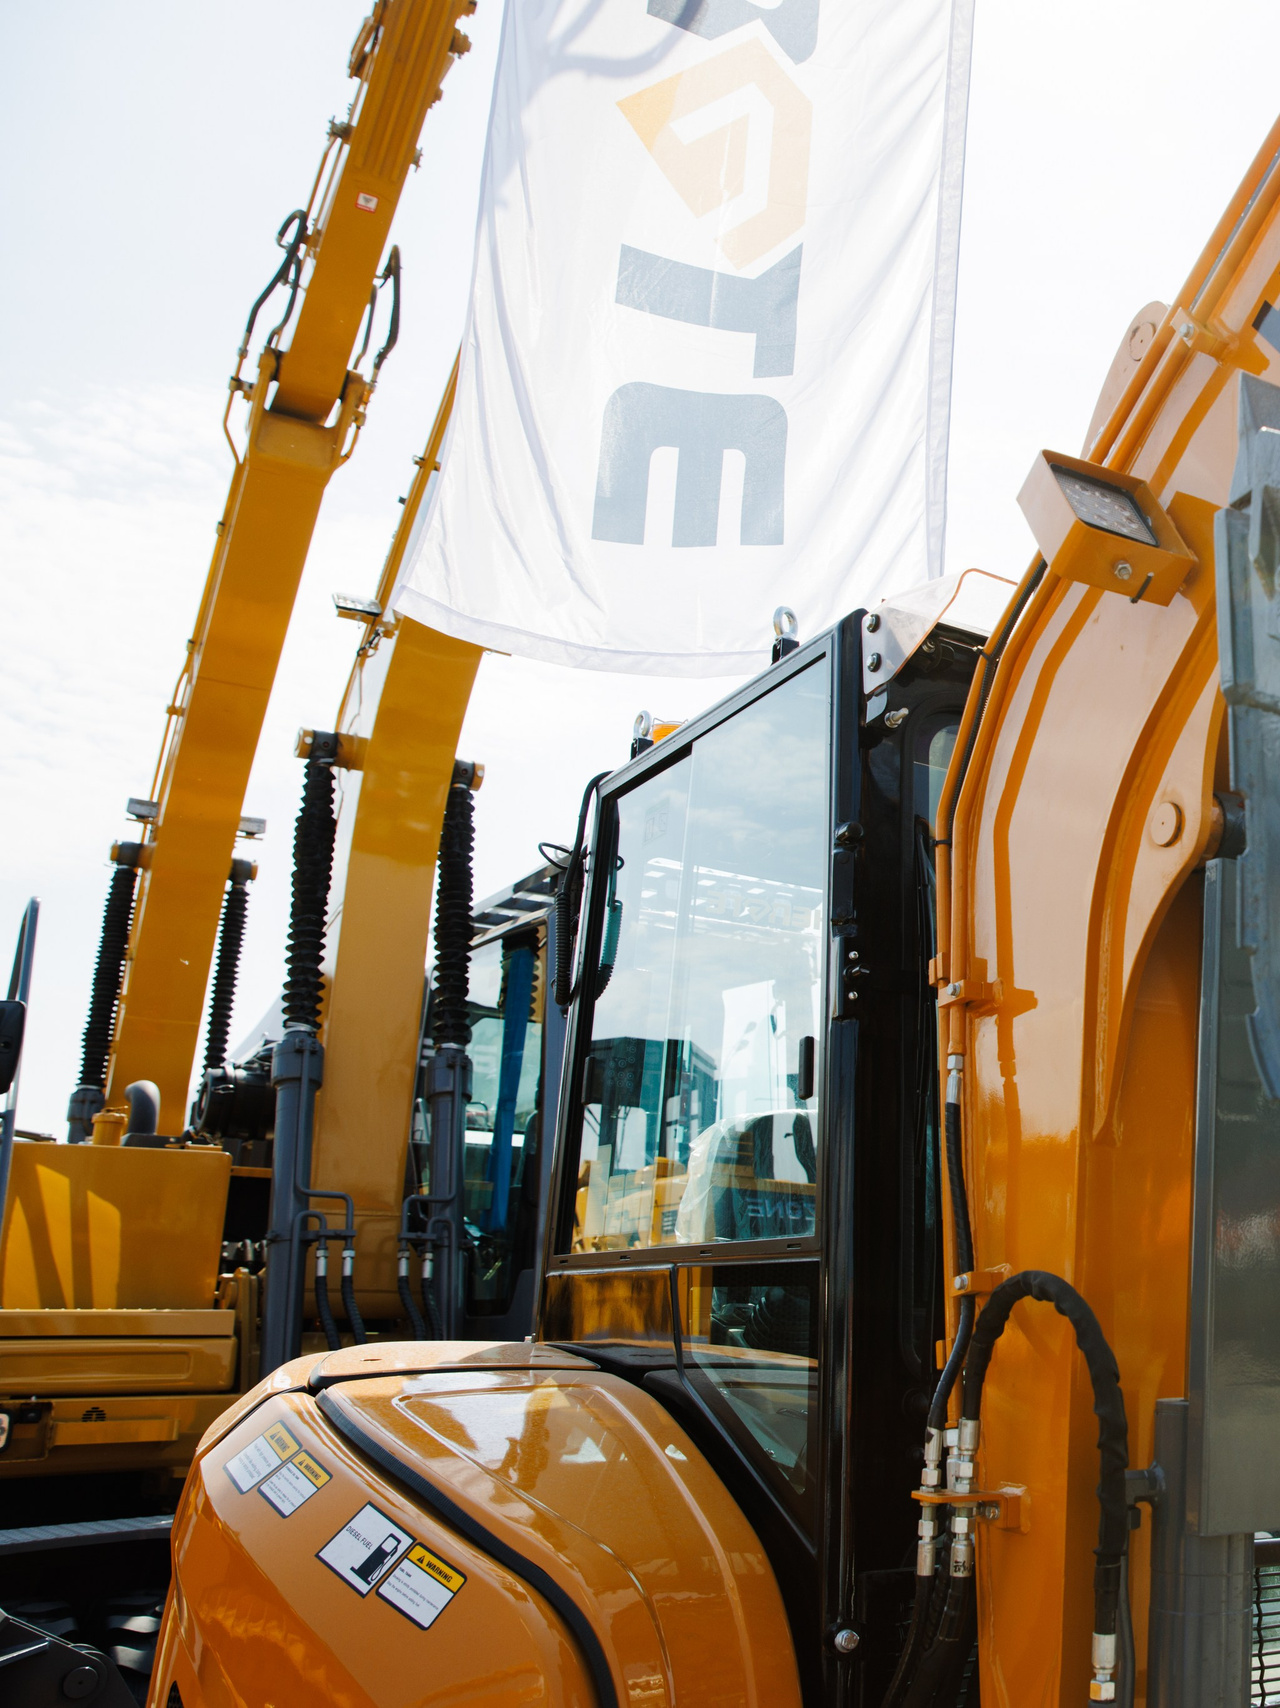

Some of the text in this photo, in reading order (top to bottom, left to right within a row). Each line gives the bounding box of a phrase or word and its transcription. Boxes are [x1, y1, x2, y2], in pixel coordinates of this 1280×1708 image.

[345, 1525, 374, 1551] DIESEL FUEL
[425, 1560, 453, 1584] WARNING
